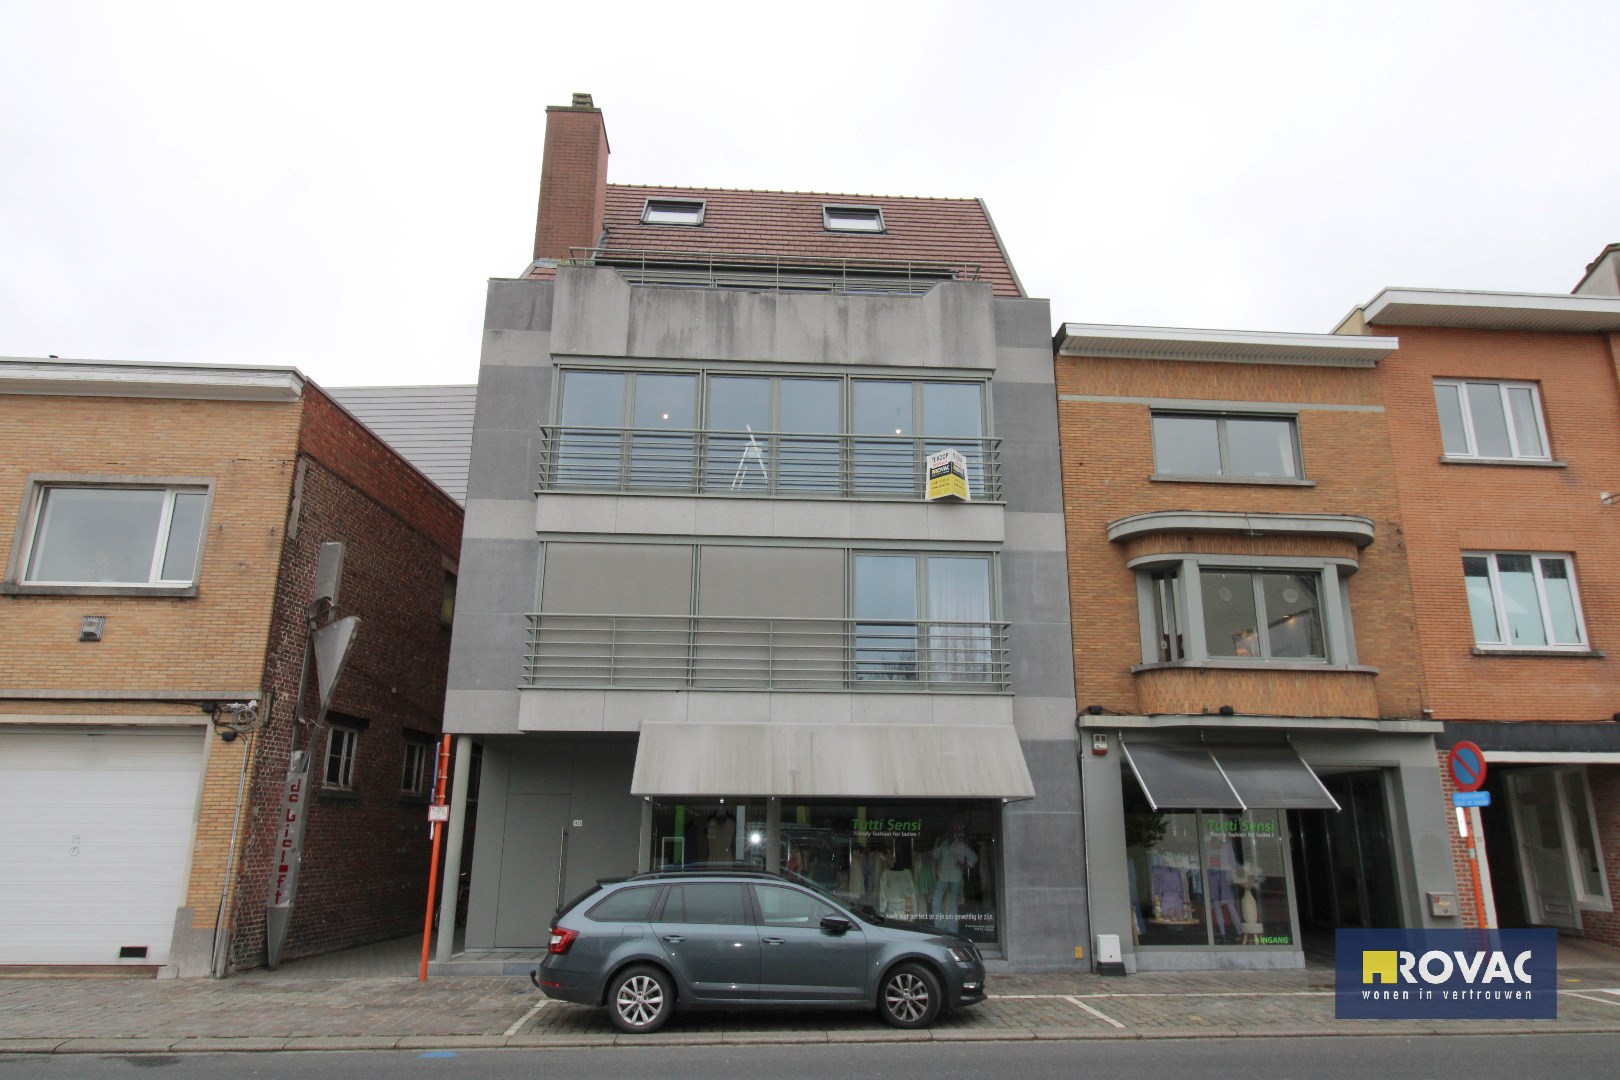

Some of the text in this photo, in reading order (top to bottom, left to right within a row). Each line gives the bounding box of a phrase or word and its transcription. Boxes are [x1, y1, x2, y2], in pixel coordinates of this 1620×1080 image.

[852, 818, 922, 831] Tutti Sensi
[1207, 819, 1275, 832] Tutti Sensi
[910, 912, 928, 921] perfect
[935, 912, 945, 921] zijn
